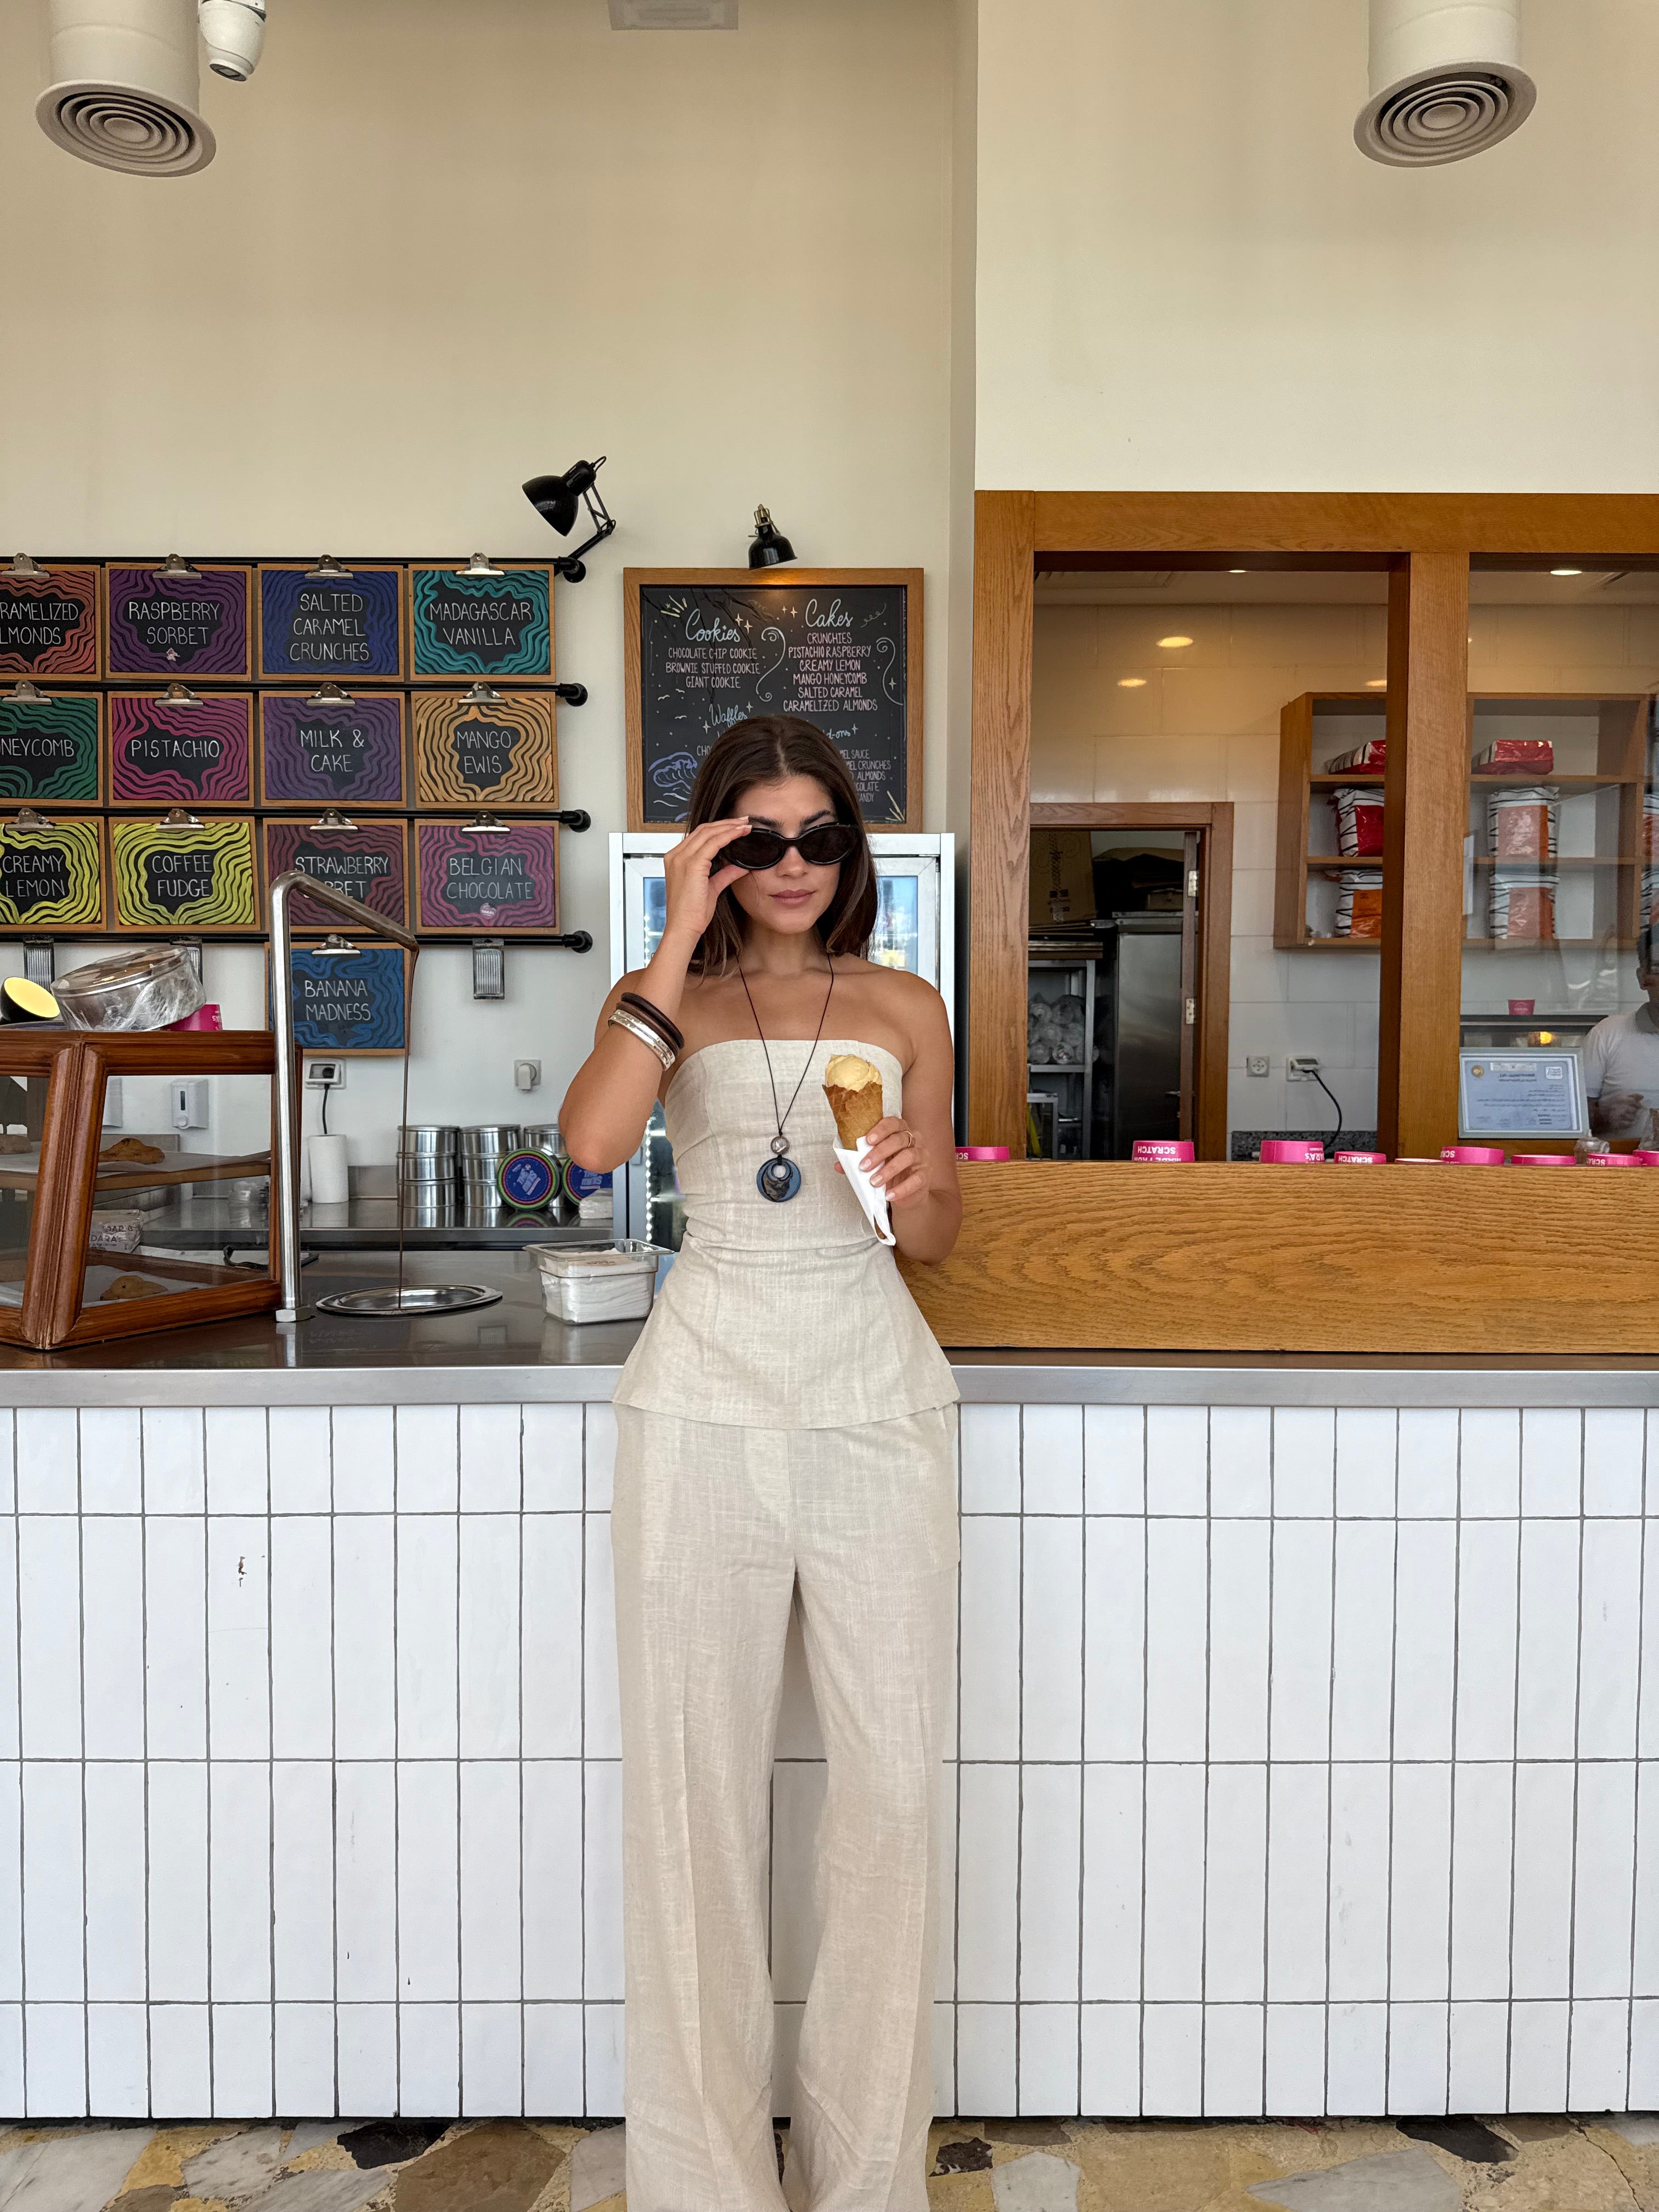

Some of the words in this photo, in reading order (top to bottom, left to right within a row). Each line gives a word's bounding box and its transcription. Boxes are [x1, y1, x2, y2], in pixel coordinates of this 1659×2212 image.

[129, 602, 220, 620] RASPBERRY
[300, 594, 363, 612] SALTED
[430, 602, 532, 622] MADAGASCAR
[805, 599, 853, 627] Cakes
[294, 618, 366, 636] CARAMEL
[686, 608, 740, 642] Cookies
[147, 627, 208, 645] SORBET
[443, 628, 516, 646] VANILLA
[807, 632, 852, 644] CRUNCHIES
[290, 643, 369, 661] CRUNCHES
[668, 647, 707, 659] CHOCOLATE
[709, 648, 727, 659] CHIP
[730, 648, 758, 659] COOKIE
[788, 646, 825, 658] PISTACHIO
[826, 645, 871, 658] RASPBERRY
[665, 662, 698, 673] BROWNIE
[702, 662, 731, 674] STUFFED
[732, 663, 761, 674] COOKIE
[799, 659, 833, 672] CREAMY
[836, 659, 861, 671] LEMON
[686, 676, 710, 688] GIANT
[711, 676, 741, 689] COOKIE
[793, 673, 822, 685] MANGO
[824, 672, 867, 685] HONEYCOMB
[798, 687, 828, 698] SALTED
[830, 687, 863, 698] CARAMEL
[783, 700, 839, 712] CARAMELIZED
[843, 699, 878, 711] ALMONDS
[709, 704, 747, 727] Waffles
[1, 738, 74, 757] NEYCOMB
[300, 730, 342, 748] MILK
[353, 729, 364, 748] &
[457, 731, 512, 749] MANGO
[131, 740, 220, 758] PISTACHIO
[851, 749, 870, 759] SAUCE
[311, 754, 354, 772] CAKE
[464, 756, 502, 775] EWIS
[858, 760, 891, 770] CRUNCHES
[857, 771, 885, 781] ALMONDS
[2, 855, 64, 873] CREAMY
[152, 855, 213, 873] COFFEE
[295, 856, 388, 874] STRAWBERRY
[450, 858, 522, 876] BELGIAN
[5, 879, 65, 898] LEMON
[157, 879, 210, 897] FUDGE
[447, 882, 533, 900] CHOCOLATE
[304, 980, 368, 997] BANANA
[306, 1003, 371, 1021] MADNESS
[1137, 1146, 1176, 1155] SCRATCH
